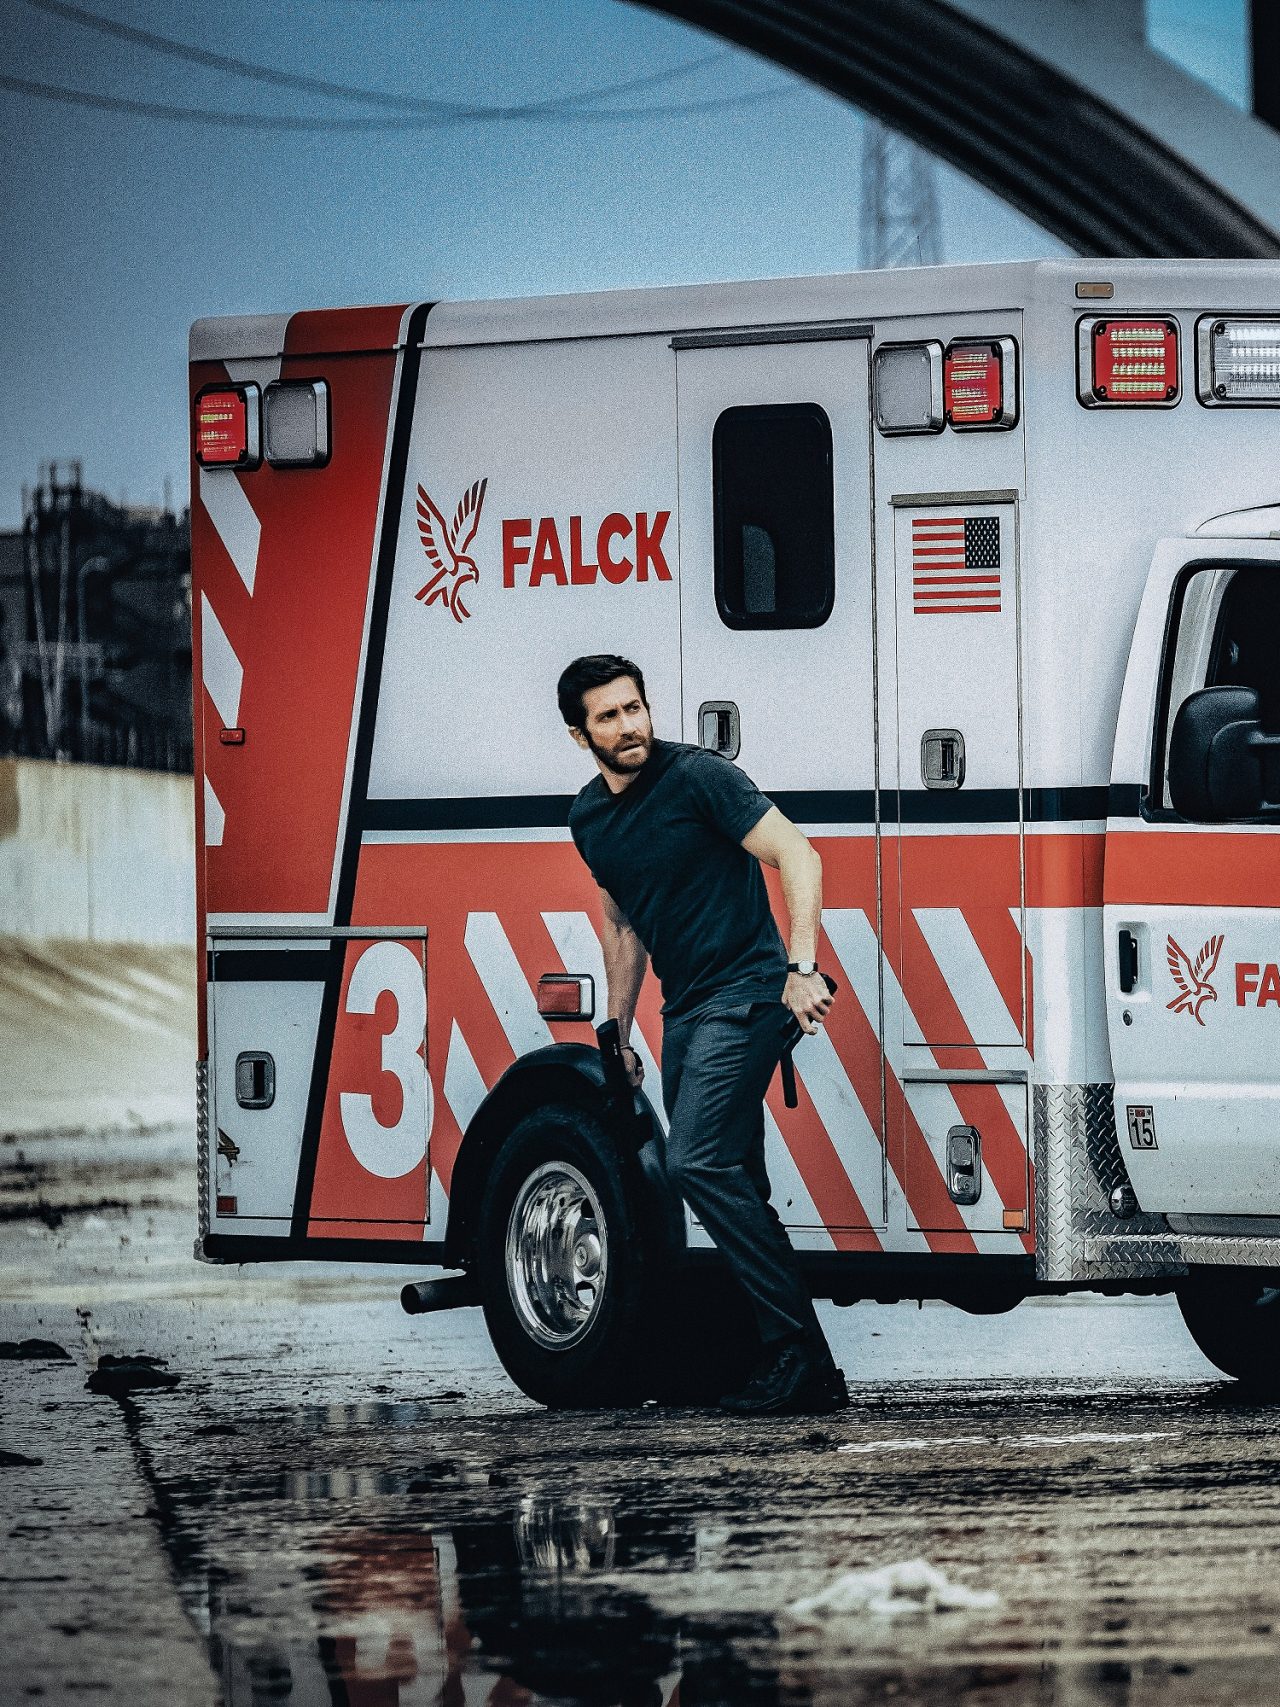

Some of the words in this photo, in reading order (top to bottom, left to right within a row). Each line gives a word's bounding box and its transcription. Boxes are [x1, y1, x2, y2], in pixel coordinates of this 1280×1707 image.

[502, 511, 672, 588] FALCK
[339, 941, 433, 1178] 3
[1131, 1118, 1153, 1146] 15
